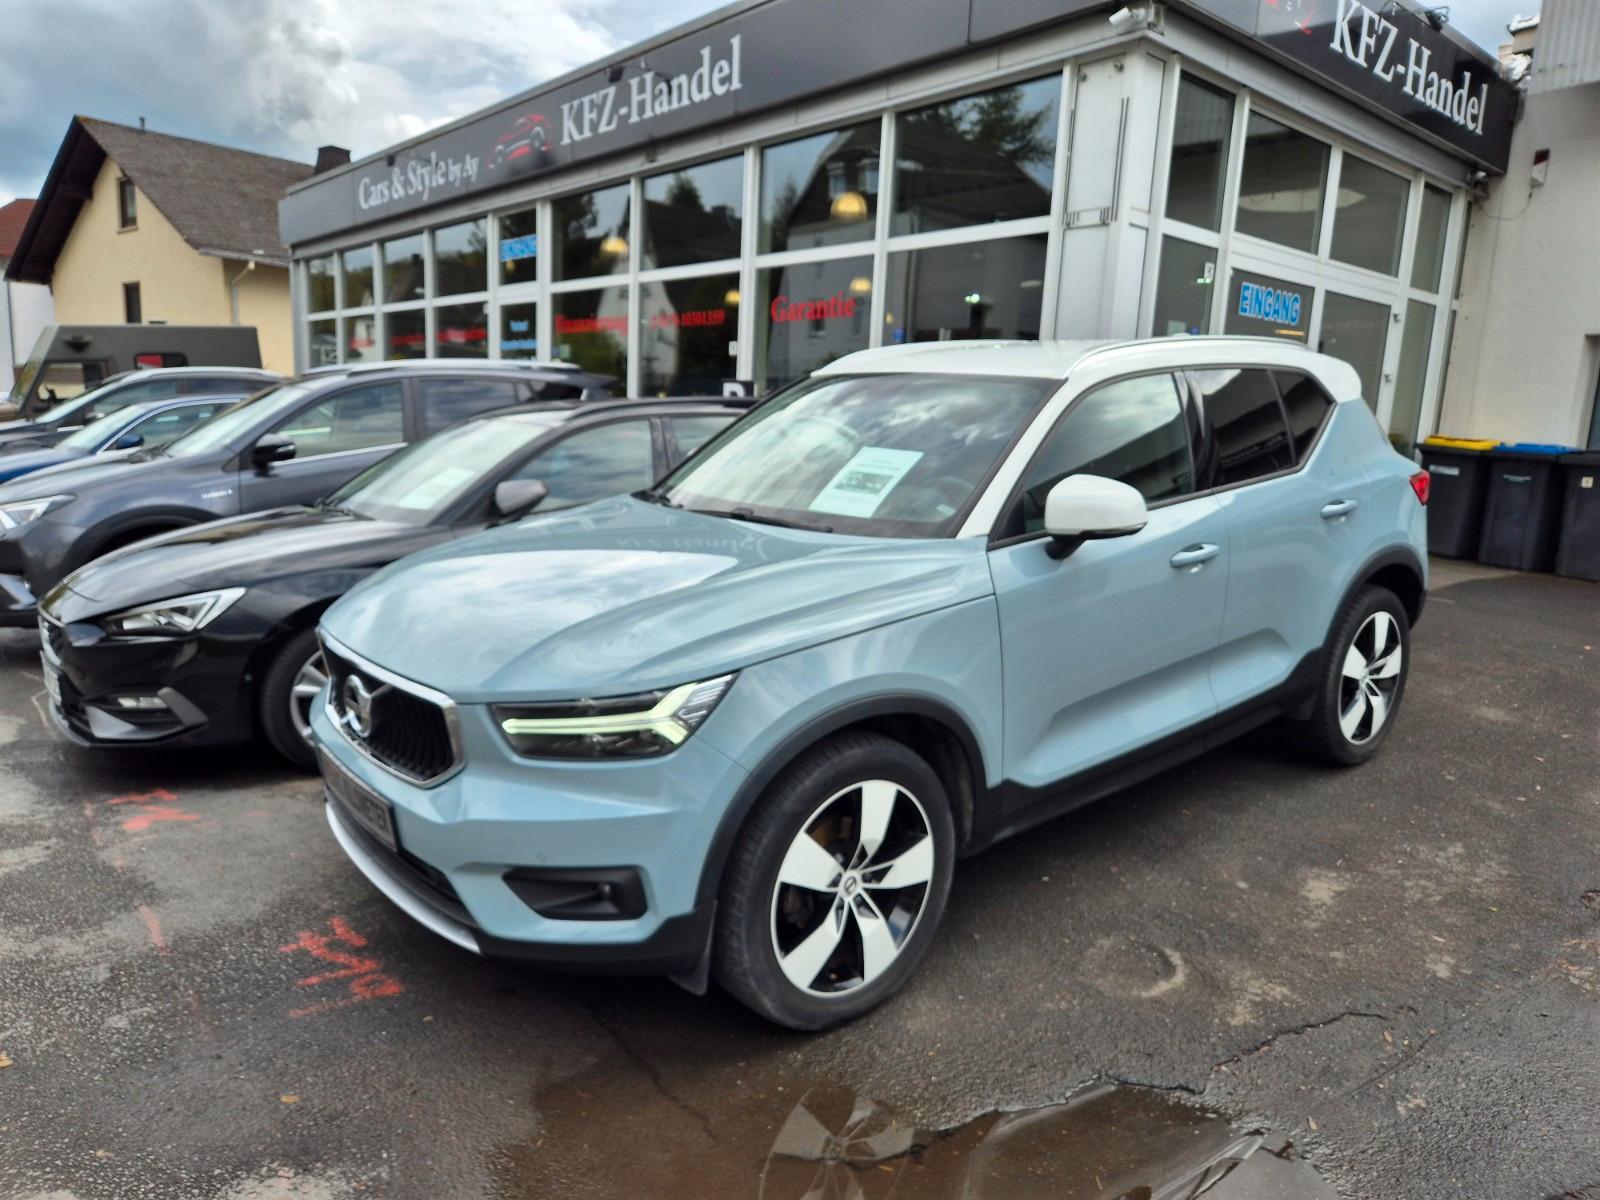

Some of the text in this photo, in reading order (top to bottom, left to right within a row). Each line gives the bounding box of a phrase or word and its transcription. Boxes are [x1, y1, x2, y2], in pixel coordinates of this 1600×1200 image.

[559, 33, 742, 146] KFZ-Handel
[1329, 0, 1488, 135] KFZ-Handel
[358, 176, 390, 210] Cars
[391, 167, 405, 199] &
[407, 150, 447, 201] Style
[770, 290, 857, 323] Garantie
[1238, 281, 1301, 328] EINGANG
